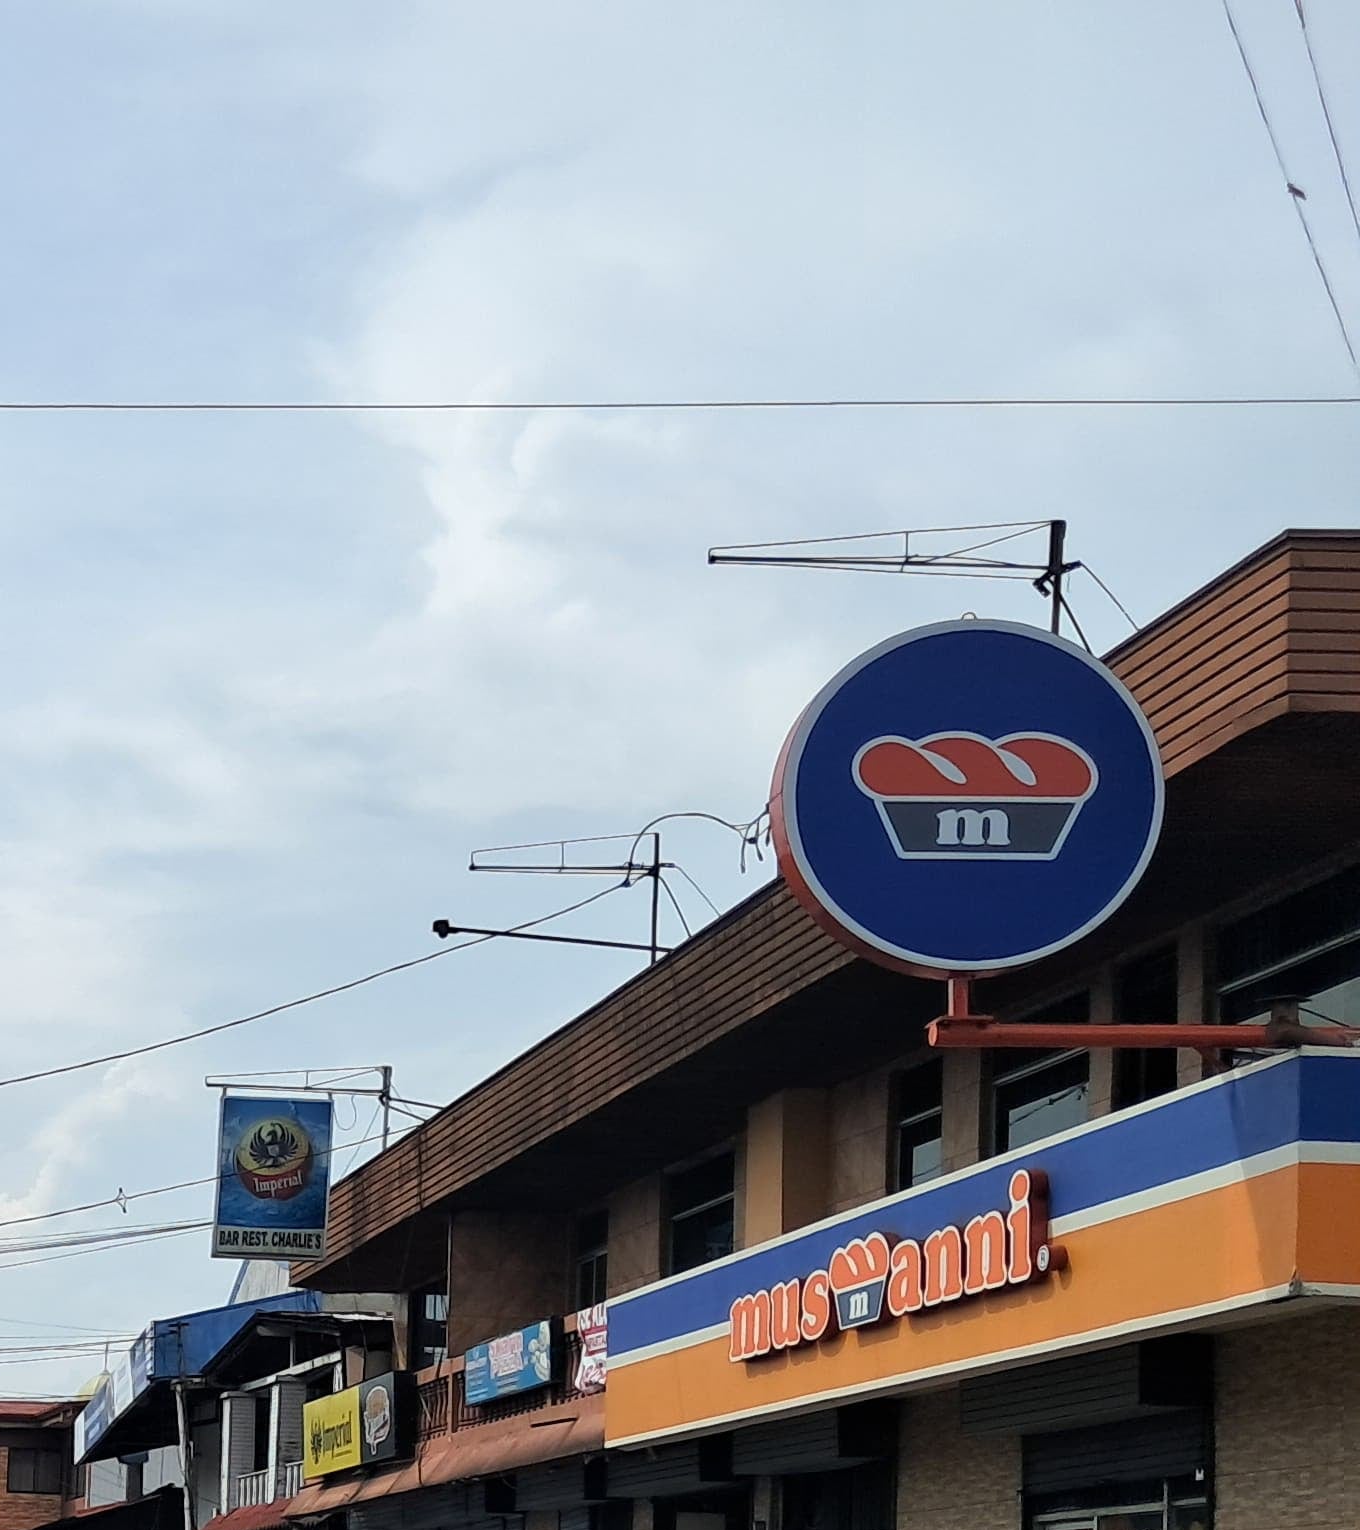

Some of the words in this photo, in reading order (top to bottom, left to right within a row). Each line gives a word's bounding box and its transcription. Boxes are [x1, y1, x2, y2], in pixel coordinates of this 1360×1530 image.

[936, 808, 1012, 846] m
[253, 1169, 303, 1198] Imperial
[219, 1230, 239, 1246] BAR
[241, 1231, 269, 1247] REST.
[271, 1231, 322, 1250] CHARLIE'S
